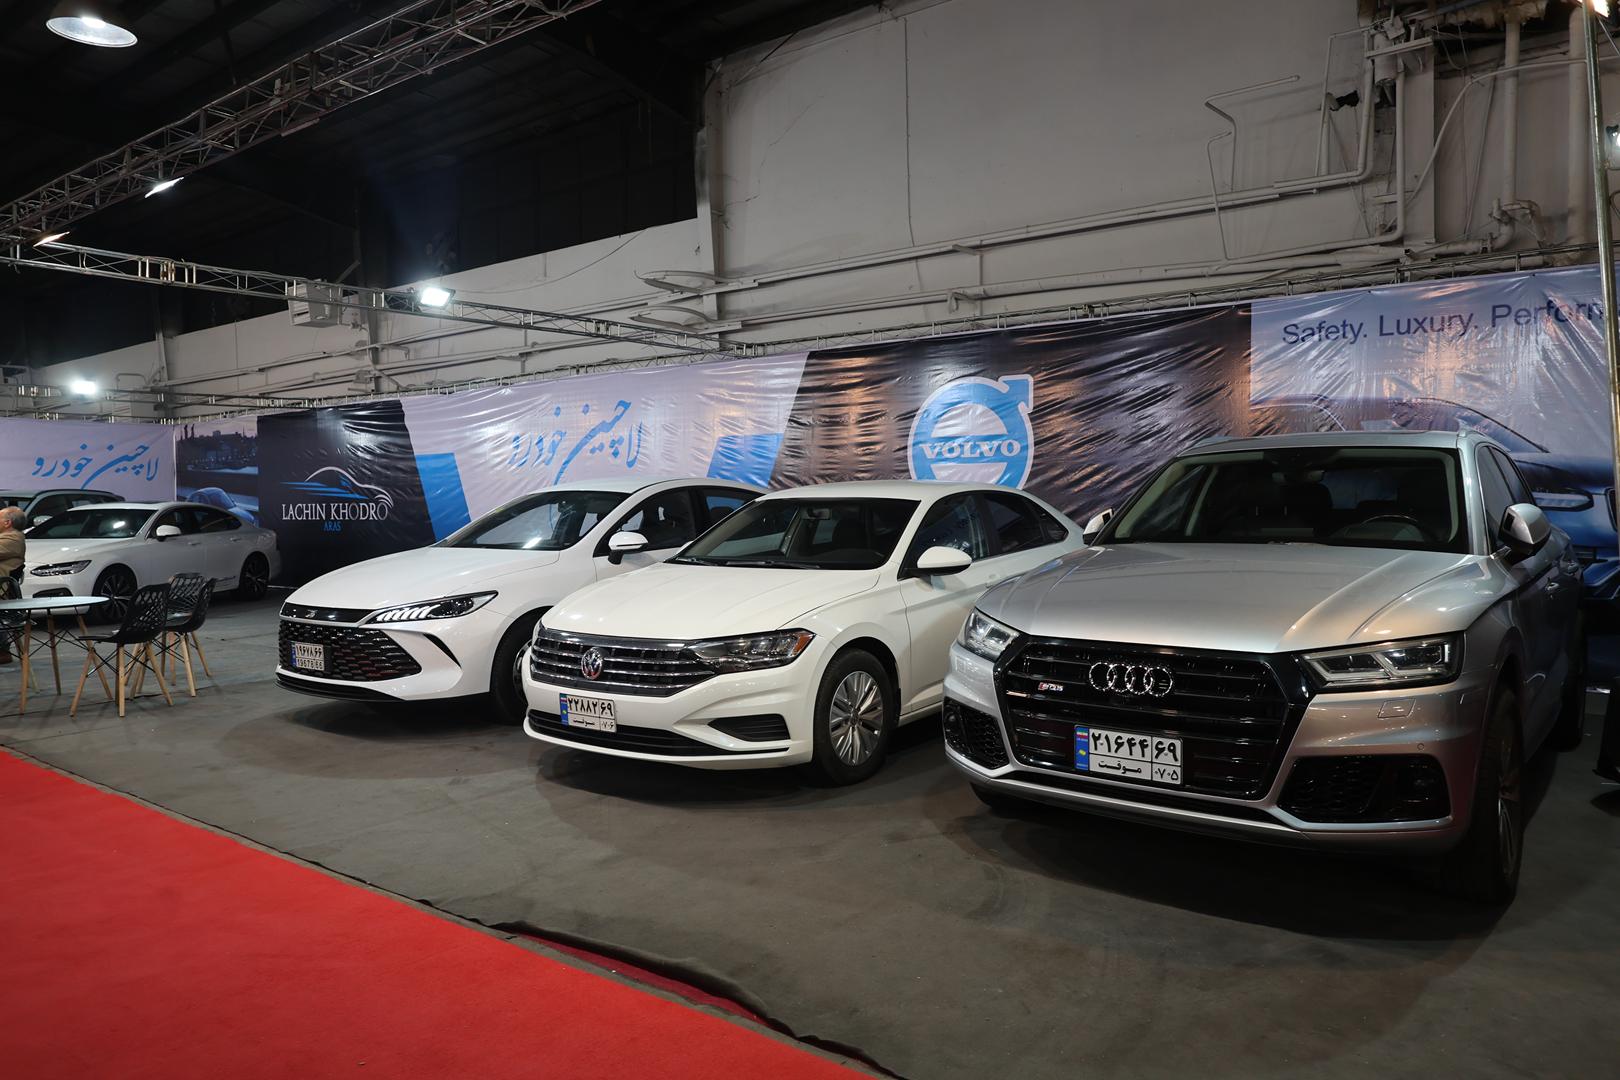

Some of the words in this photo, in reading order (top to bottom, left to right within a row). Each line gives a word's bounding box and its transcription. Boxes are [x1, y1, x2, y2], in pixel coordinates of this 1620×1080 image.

[1282, 319, 1367, 345] Safety.
[1379, 312, 1478, 337] Luxury.
[919, 439, 1021, 459] VOLVO
[282, 503, 326, 520] LACHIN
[330, 502, 389, 521] KHODRO
[323, 521, 342, 532] ARAS
[1091, 732, 1150, 758] ۲۱۶۴۴
[1154, 740, 1179, 762] ۶۹
[1098, 760, 1143, 775] موقت
